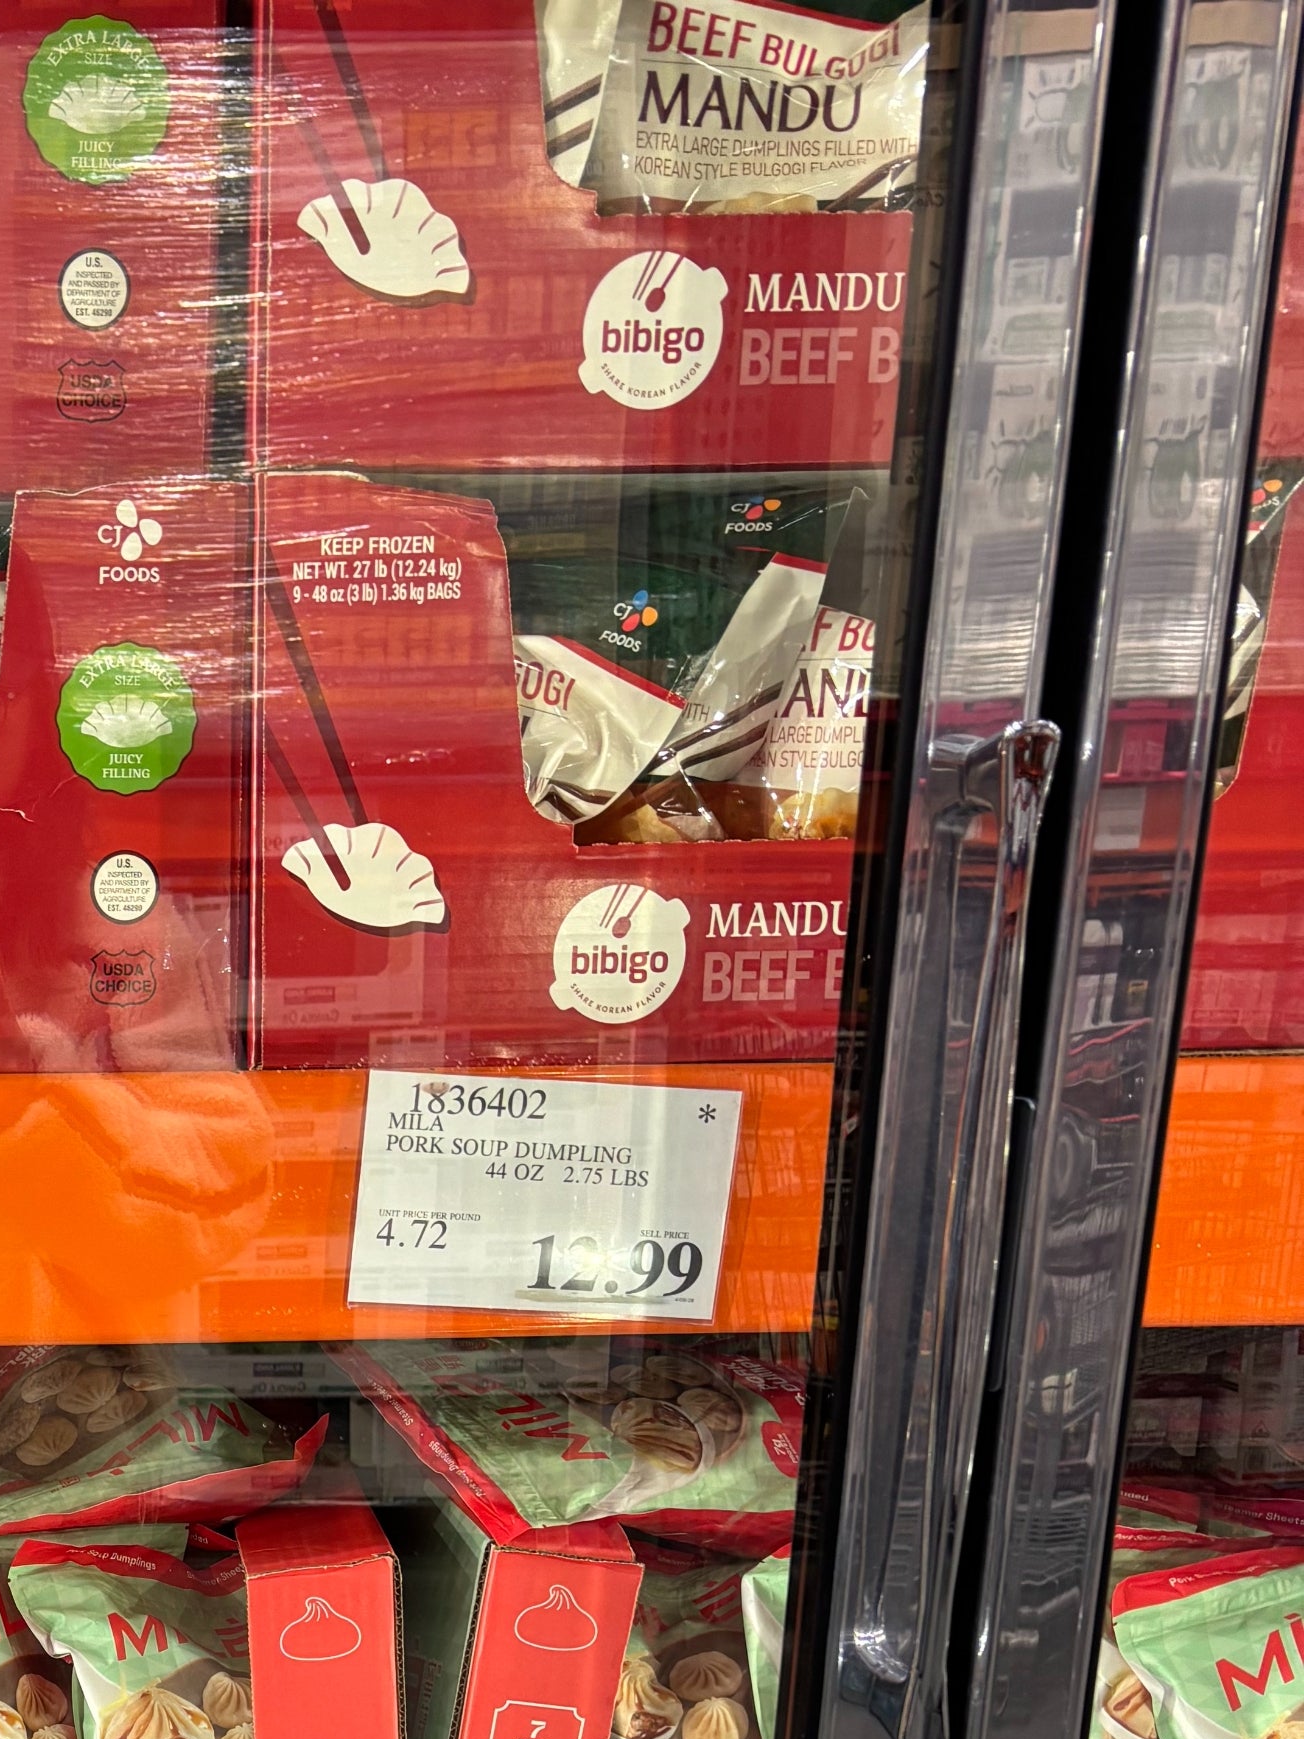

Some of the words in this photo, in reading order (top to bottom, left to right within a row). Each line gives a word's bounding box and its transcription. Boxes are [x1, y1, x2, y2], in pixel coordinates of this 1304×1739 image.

[647, 1, 754, 65] BEEF
[47, 30, 96, 67] EXTRA
[84, 52, 112, 65] SIZE
[638, 70, 861, 132] MANDU
[78, 141, 114, 153] JUICY
[744, 272, 905, 314] MANDU
[602, 320, 704, 364] bibigo
[738, 328, 857, 386] BEEF
[70, 374, 112, 388] USDA
[61, 394, 122, 408] CHOICE
[731, 501, 750, 515] CJ
[97, 524, 120, 548] CJ
[724, 522, 773, 535] FOODS
[320, 537, 364, 556] KEEP
[368, 536, 435, 555] FROZEN
[98, 567, 160, 583] FOODS
[613, 602, 633, 619] CJ
[598, 629, 642, 653] FOODS
[78, 654, 129, 690] EXTRA
[131, 654, 176, 693] LARGE
[114, 674, 142, 686] SIZE
[108, 754, 144, 767] JUICY
[102, 767, 151, 780] FILLING
[117, 859, 133, 868] U.S.
[103, 964, 144, 976] USDA
[571, 945, 669, 984] bibigo
[702, 949, 814, 1002] BEEF
[96, 980, 152, 992] CHOICE
[409, 1082, 547, 1120] 1836402
[388, 1112, 444, 1132] MILA
[386, 1134, 444, 1155] PORK
[451, 1138, 508, 1159] SOUP
[514, 1141, 632, 1165] DUMPLING
[485, 1162, 506, 1179] 44
[514, 1164, 544, 1182] OZ
[563, 1166, 603, 1185] 2.75
[610, 1169, 649, 1188] LBS
[379, 1209, 401, 1218] UNIT
[403, 1210, 428, 1220] PRICE
[431, 1212, 448, 1220] PER
[450, 1213, 481, 1222] POUND
[376, 1219, 448, 1251] 4.72
[640, 1229, 662, 1238] SELL
[663, 1230, 689, 1240] PRICE
[526, 1235, 703, 1298] 12.99
[110, 1552, 156, 1571] Dumplings
